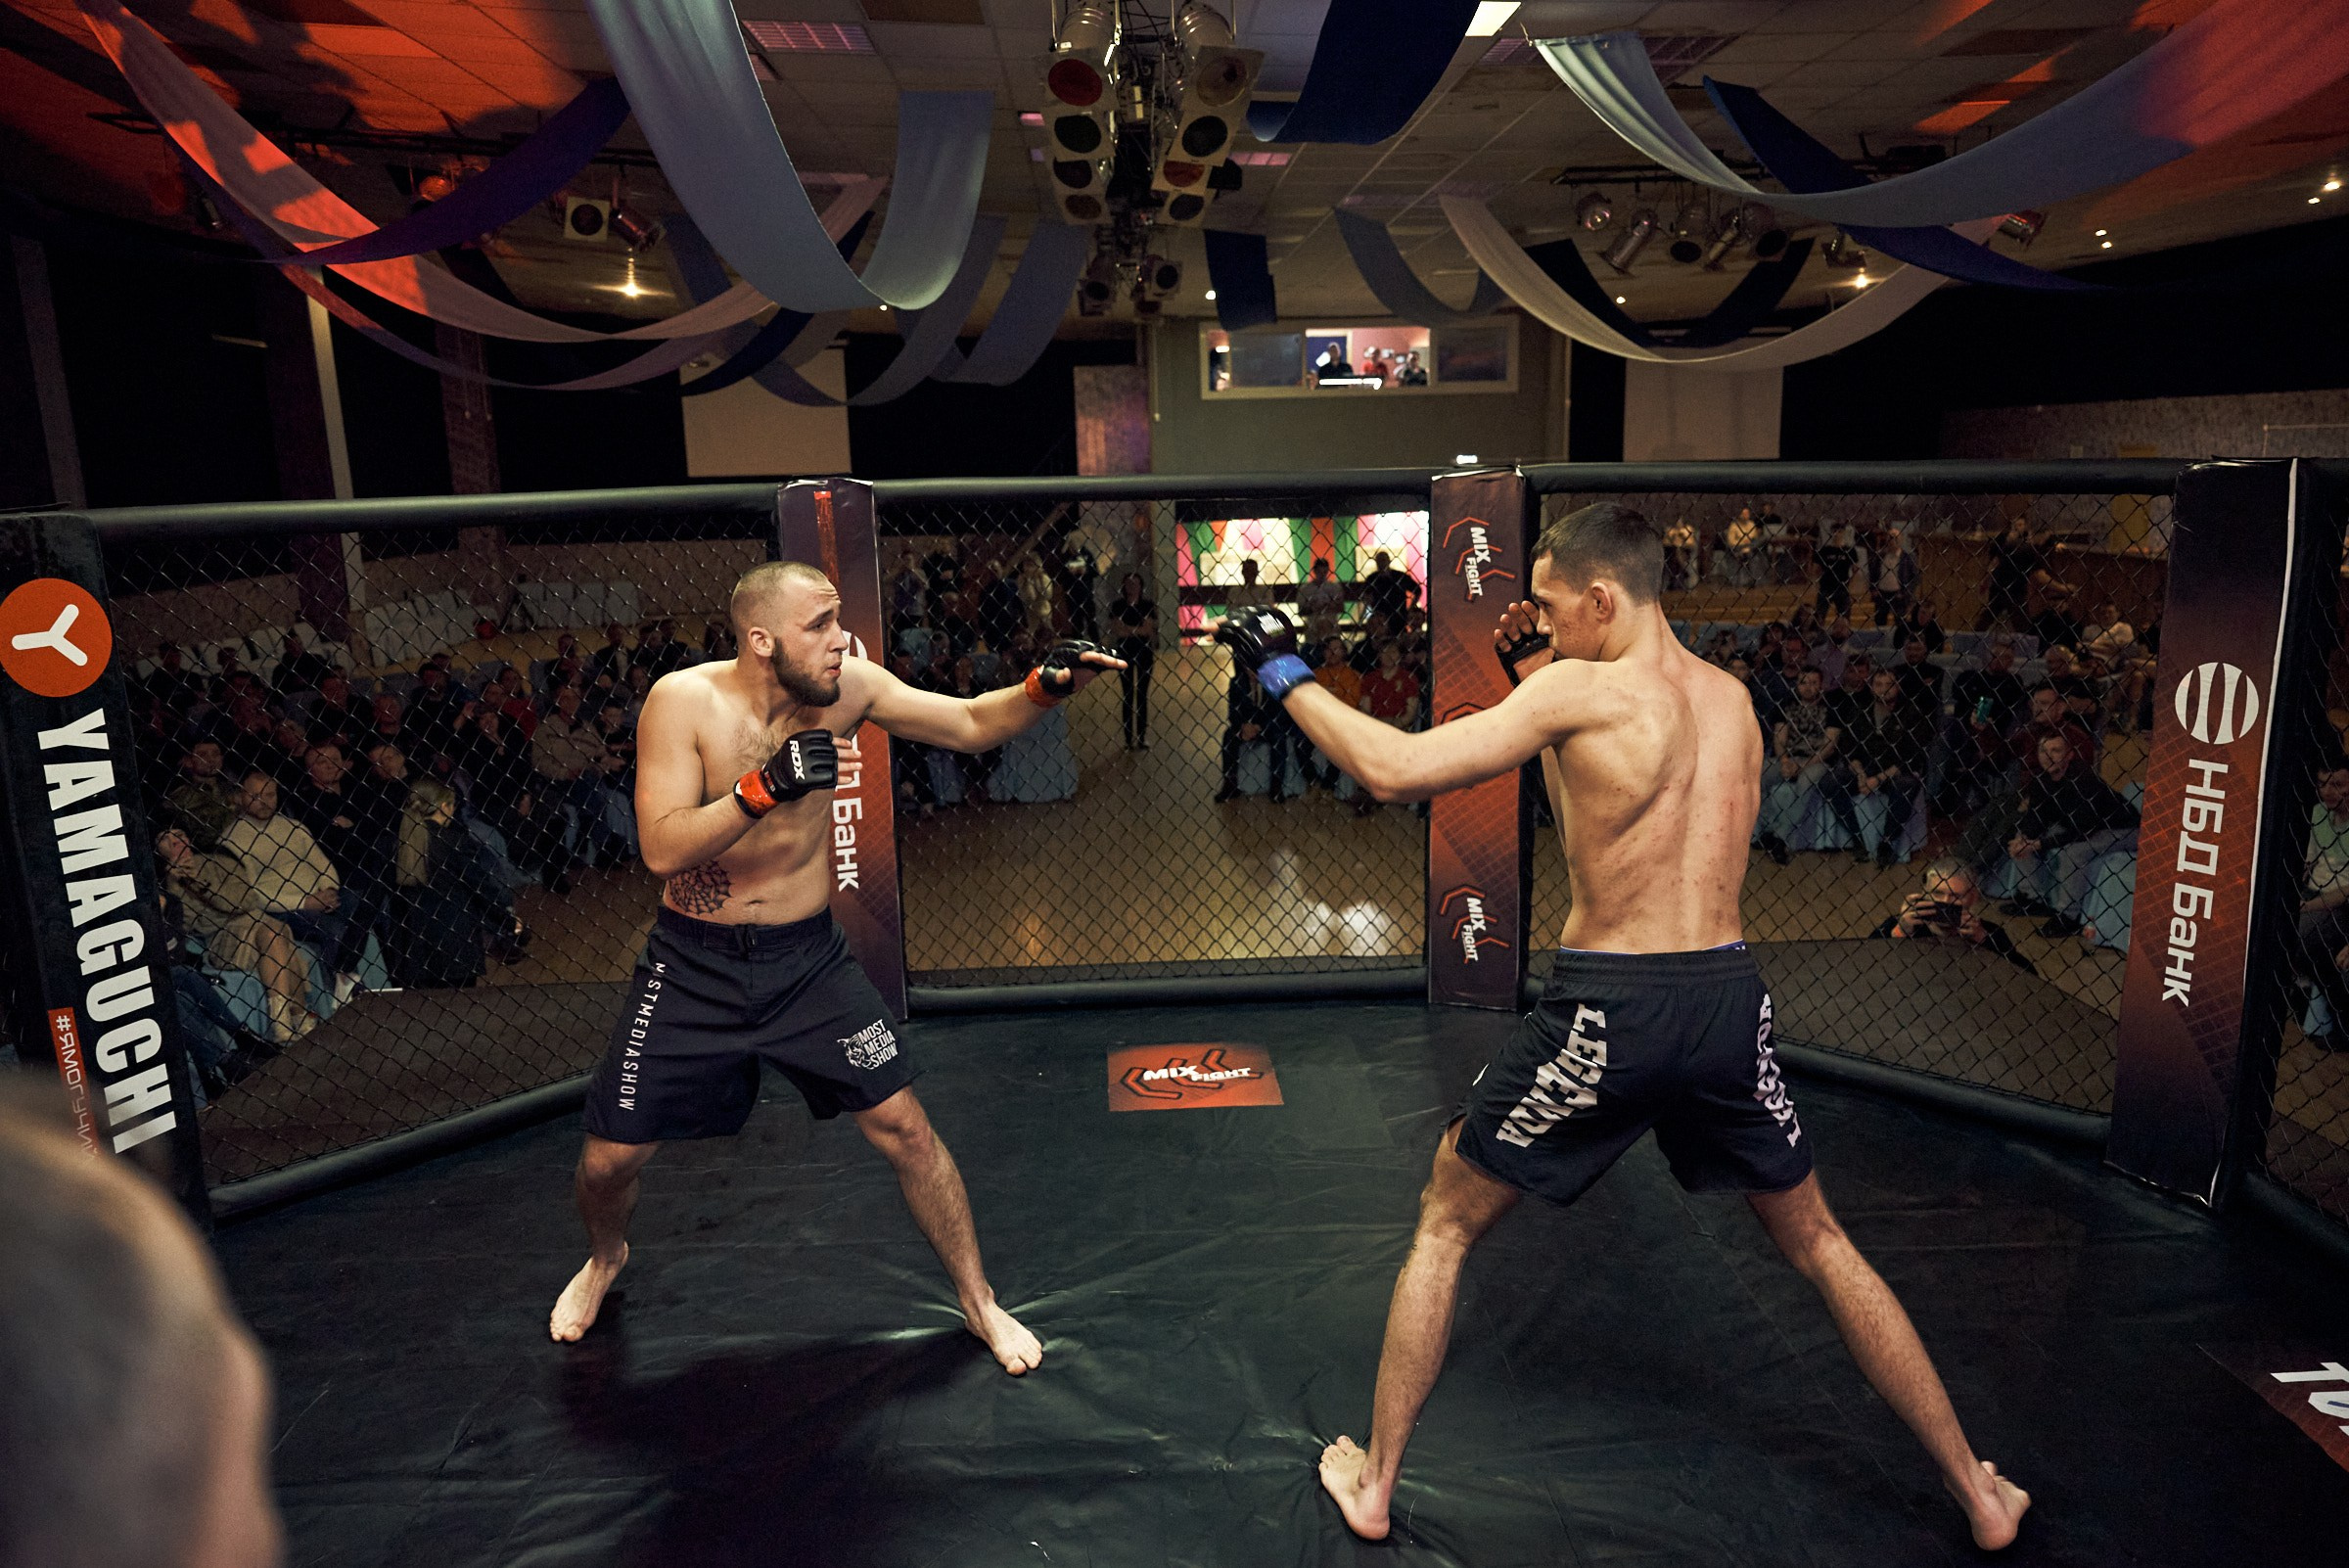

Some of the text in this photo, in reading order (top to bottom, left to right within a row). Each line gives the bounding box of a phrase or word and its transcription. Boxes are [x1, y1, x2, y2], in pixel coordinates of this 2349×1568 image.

[1470, 527, 1492, 564] MIX
[1466, 557, 1483, 596] FIGHT
[789, 740, 806, 780] RDX
[833, 798, 863, 892] Банк
[2162, 759, 2229, 1007] НБД Банк
[37, 708, 177, 1154] YAMAGUCHI
[1466, 898, 1487, 931] MIX
[1462, 925, 1478, 961] FIGHT
[619, 962, 666, 1111] MSTMEDIASHOW
[857, 1019, 886, 1044] MOST
[863, 1030, 896, 1056] MEDIA
[869, 1042, 898, 1068] SHOW
[1143, 1065, 1251, 1082] MIX FIGHT
[1496, 1003, 1606, 1148] LEGENDA
